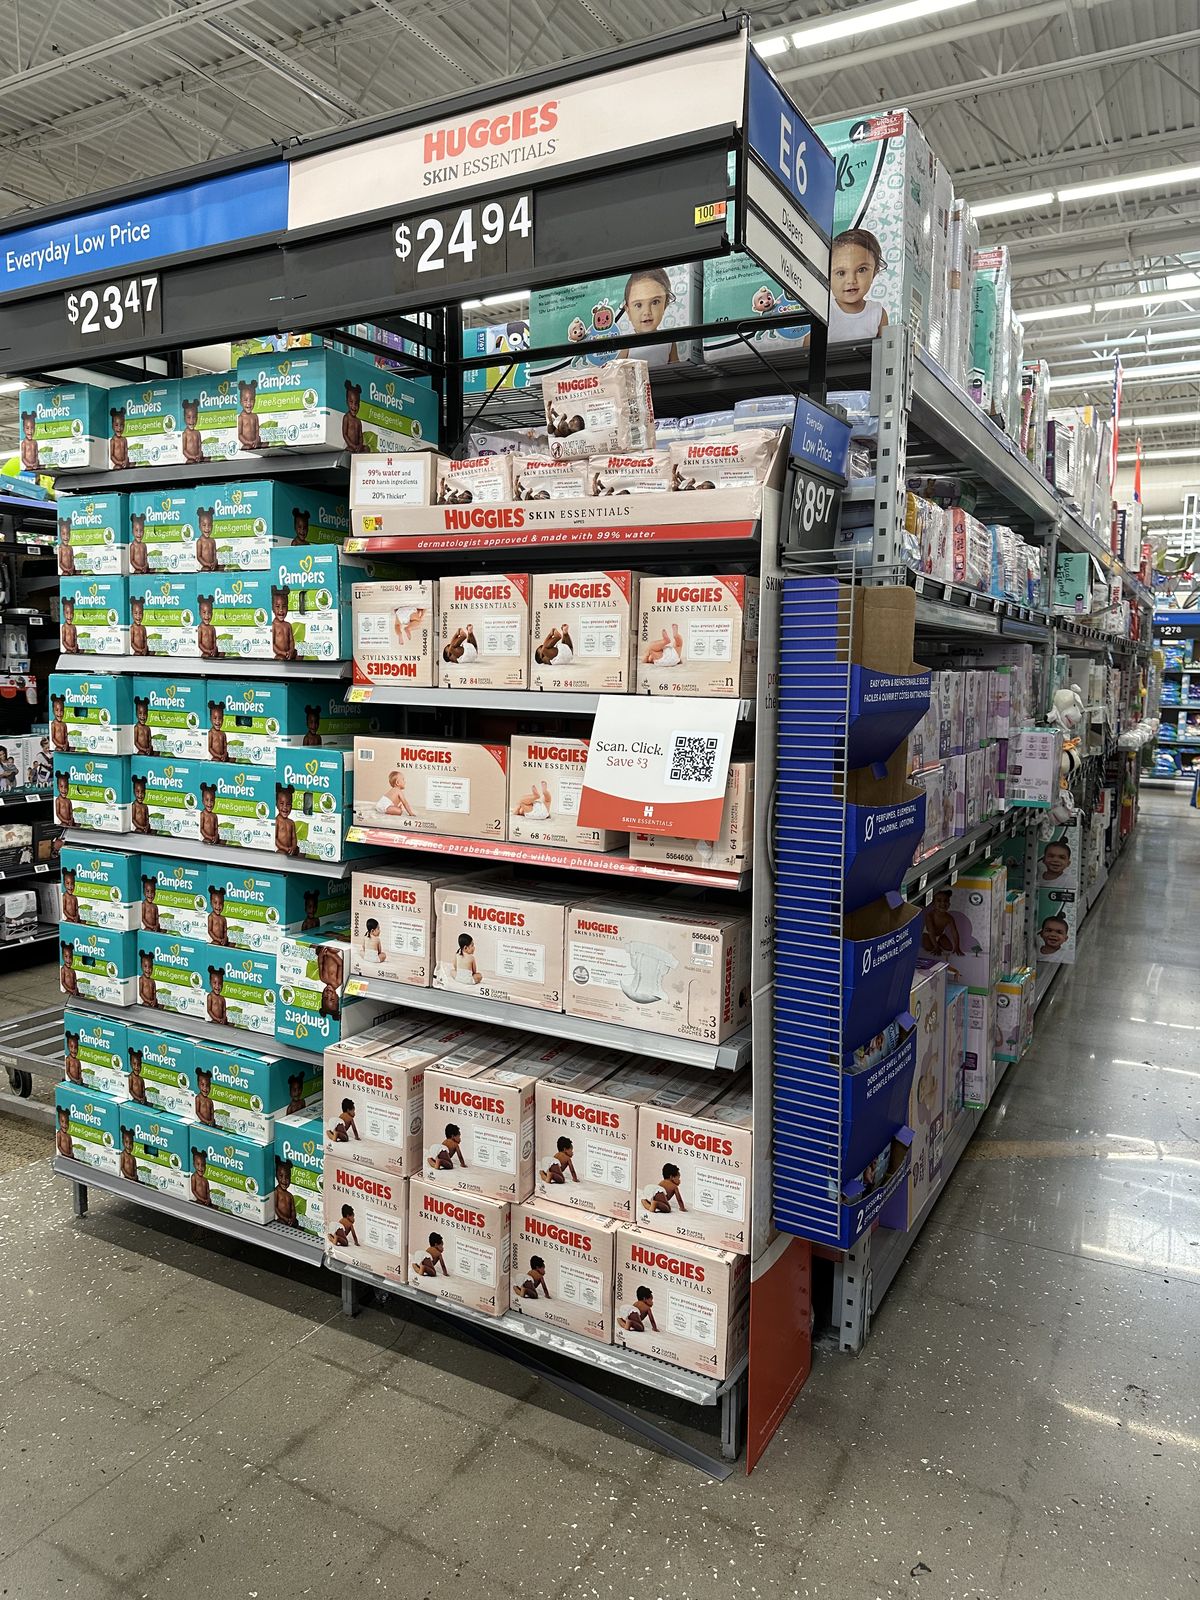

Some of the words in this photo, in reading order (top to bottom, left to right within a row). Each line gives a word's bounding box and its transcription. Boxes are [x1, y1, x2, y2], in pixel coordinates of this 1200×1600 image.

[423, 101, 558, 164] HUGGIES
[853, 125, 865, 139] 4
[779, 112, 808, 195] E6
[423, 165, 459, 186] SKIN
[781, 208, 804, 245] Diapers
[6, 242, 71, 272] Everyday
[75, 235, 105, 256] Low
[110, 222, 151, 247] Price
[780, 255, 803, 289] Walkers
[257, 371, 301, 390] Pampers
[557, 376, 599, 394] HUGGIES
[370, 382, 403, 411] Pampers
[555, 394, 568, 402] SKIN
[126, 399, 161, 416] Pampers
[806, 413, 824, 434] Everyday
[688, 445, 739, 458] HUGGIES
[802, 432, 815, 454] Low
[816, 439, 832, 463] Price
[368, 469, 382, 477] 99%
[382, 469, 401, 477] water
[450, 457, 490, 472] HUGGIES
[391, 478, 418, 486] ingredients
[372, 492, 386, 500] 20%
[146, 506, 180, 523] Pampers
[214, 499, 251, 517] Pampers
[445, 508, 524, 531] HUGGIES
[528, 510, 555, 520] SKIN
[560, 507, 628, 519] ESSENTIALS
[417, 538, 481, 549] dermatologist
[484, 535, 527, 546] approved
[541, 534, 567, 542] made
[571, 532, 593, 541] with
[596, 531, 620, 540] 99%
[625, 530, 655, 539] water
[278, 566, 324, 587] Pampers
[214, 588, 252, 606] Pampers
[454, 585, 511, 601] HUGGIES
[549, 583, 611, 599] HUGGIES
[656, 587, 722, 603] HUGGIES
[367, 663, 416, 678] HUGGIES
[659, 683, 669, 691] 68
[672, 683, 681, 691] 76
[725, 677, 734, 687] n
[225, 695, 264, 715] Pampers
[400, 747, 452, 764] HUGGIES
[528, 745, 588, 763] HUGGIES
[596, 741, 628, 753] Scan.
[631, 742, 664, 756] Click.
[607, 756, 634, 768] Save
[636, 758, 649, 769] $3
[147, 770, 183, 789] Pampers
[284, 765, 329, 789] Pampers
[217, 778, 254, 798] Pampers
[494, 819, 501, 830] 2
[449, 844, 490, 855] parabens
[530, 853, 568, 864] without
[570, 857, 625, 872] phthalates
[226, 882, 264, 902] Pampers
[363, 884, 416, 905] HUGGIES
[464, 920, 481, 929] SKIN
[468, 905, 525, 927] HUGGIES
[577, 920, 618, 935] HUGGIES
[154, 946, 189, 967] Pampers
[225, 963, 262, 984] Pampers
[479, 987, 490, 997] 58
[552, 990, 559, 1002] 3
[285, 1009, 330, 1037] Pampers
[709, 1016, 717, 1028] 3
[703, 1029, 716, 1040] 58
[143, 1045, 176, 1068] Pampers
[212, 1065, 248, 1089] Pampers
[336, 1063, 393, 1091] HUGGIES
[439, 1086, 505, 1115] HUGGIES
[546, 1115, 567, 1126] SKIN
[551, 1098, 620, 1129] HUGGIES
[135, 1124, 168, 1148] Pampers
[656, 1123, 733, 1156] HUGGIES
[650, 1140, 674, 1153] SKIN
[336, 1169, 392, 1200] HUGGIES
[569, 1196, 579, 1205] 52
[623, 1199, 631, 1212] 4
[423, 1195, 485, 1229] HUGGIES
[519, 1232, 541, 1246] SKIN
[525, 1216, 592, 1252] HUGGIES
[676, 1226, 686, 1236] 52
[735, 1231, 744, 1243] 4
[625, 1262, 649, 1277] SKIN
[631, 1244, 705, 1282] HUGGIES
[651, 1346, 661, 1355] 52
[709, 1354, 718, 1366] 4
